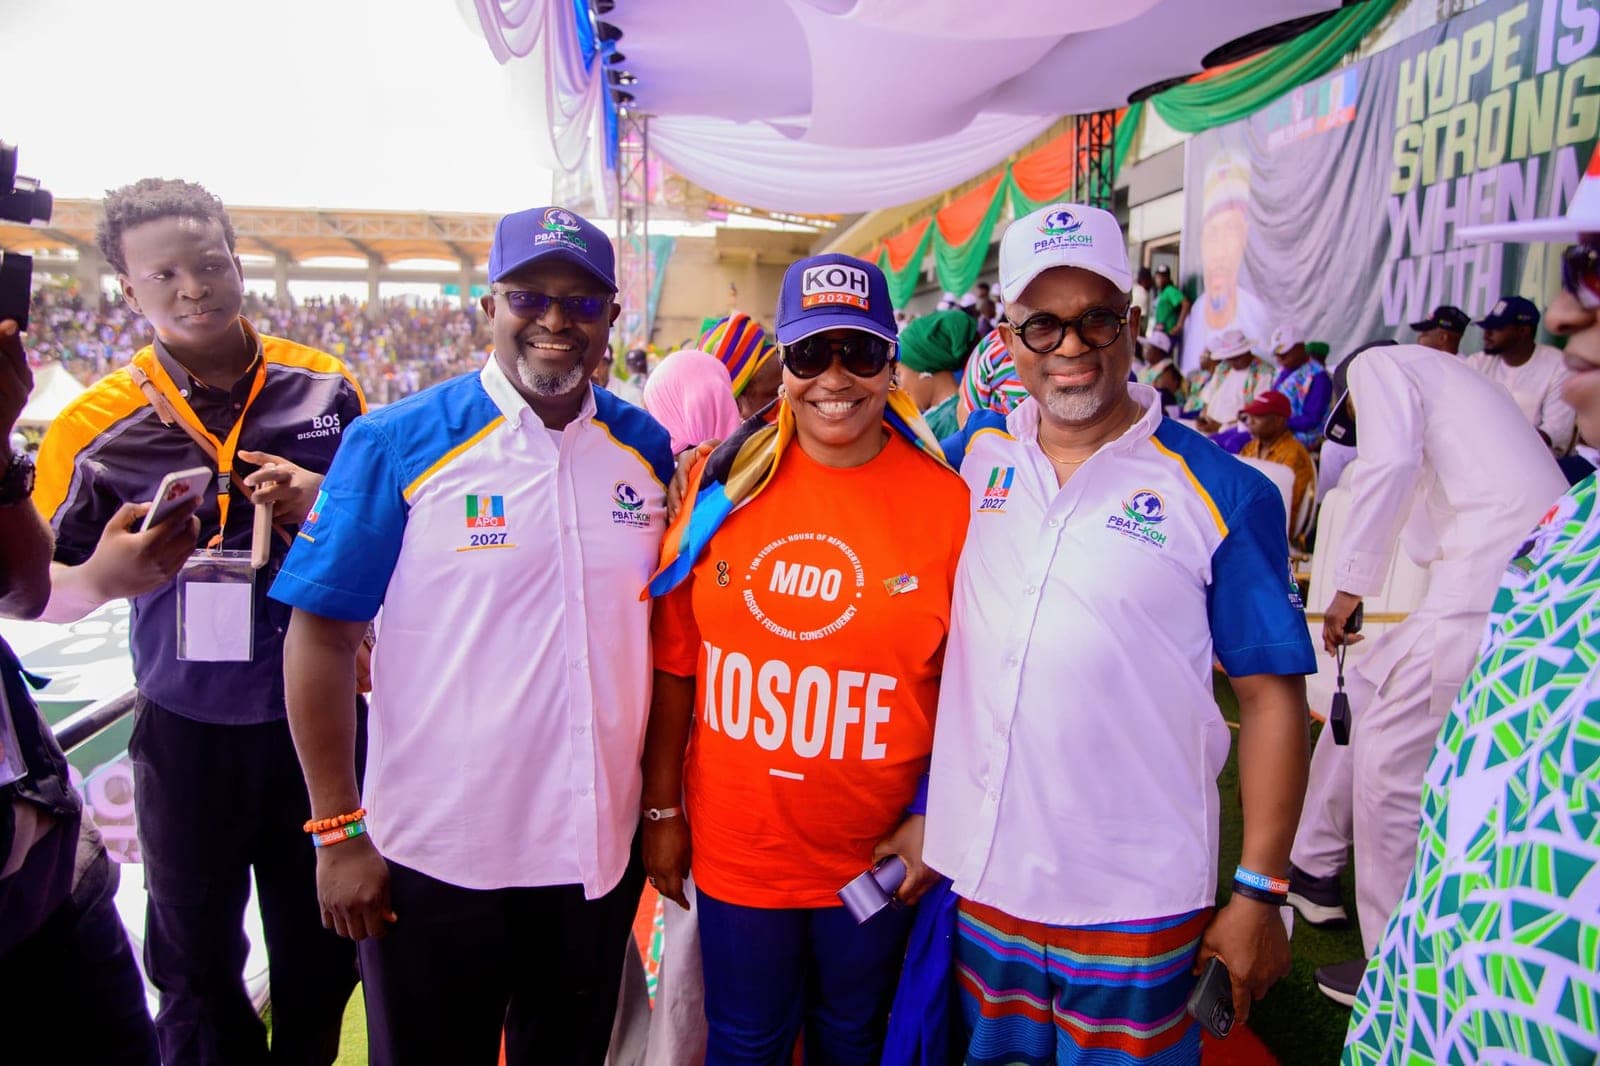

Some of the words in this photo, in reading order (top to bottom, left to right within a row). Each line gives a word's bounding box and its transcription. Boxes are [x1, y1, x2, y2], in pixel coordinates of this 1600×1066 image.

[1396, 2, 1528, 125] HOPE
[1535, 0, 1600, 75] IS
[1391, 57, 1600, 195] STRONG
[1387, 157, 1540, 260] WHEN
[534, 231, 587, 249] PBAT-KOH
[1034, 234, 1093, 250] PBAT-KOH
[805, 268, 866, 293] KOH
[1381, 242, 1503, 326] WITH
[818, 294, 854, 303] 2027
[297, 429, 329, 440] BISCON
[330, 427, 340, 435] TV
[313, 413, 340, 429] BOS
[980, 498, 1006, 508] 2027
[470, 533, 507, 546] 2027
[1108, 516, 1167, 545] PBAT-KOH
[750, 557, 762, 570] FOR
[758, 538, 787, 558] FEDERAL
[788, 532, 814, 542] HOUSE
[816, 533, 827, 541] OF
[827, 536, 864, 587] REPRESENTATIVES
[769, 560, 842, 601] MDO
[742, 589, 765, 621] KOSOFE
[762, 618, 797, 640] FEDERAL
[800, 604, 857, 640] CONSTITUENCY
[703, 640, 898, 760] KOSOFE
